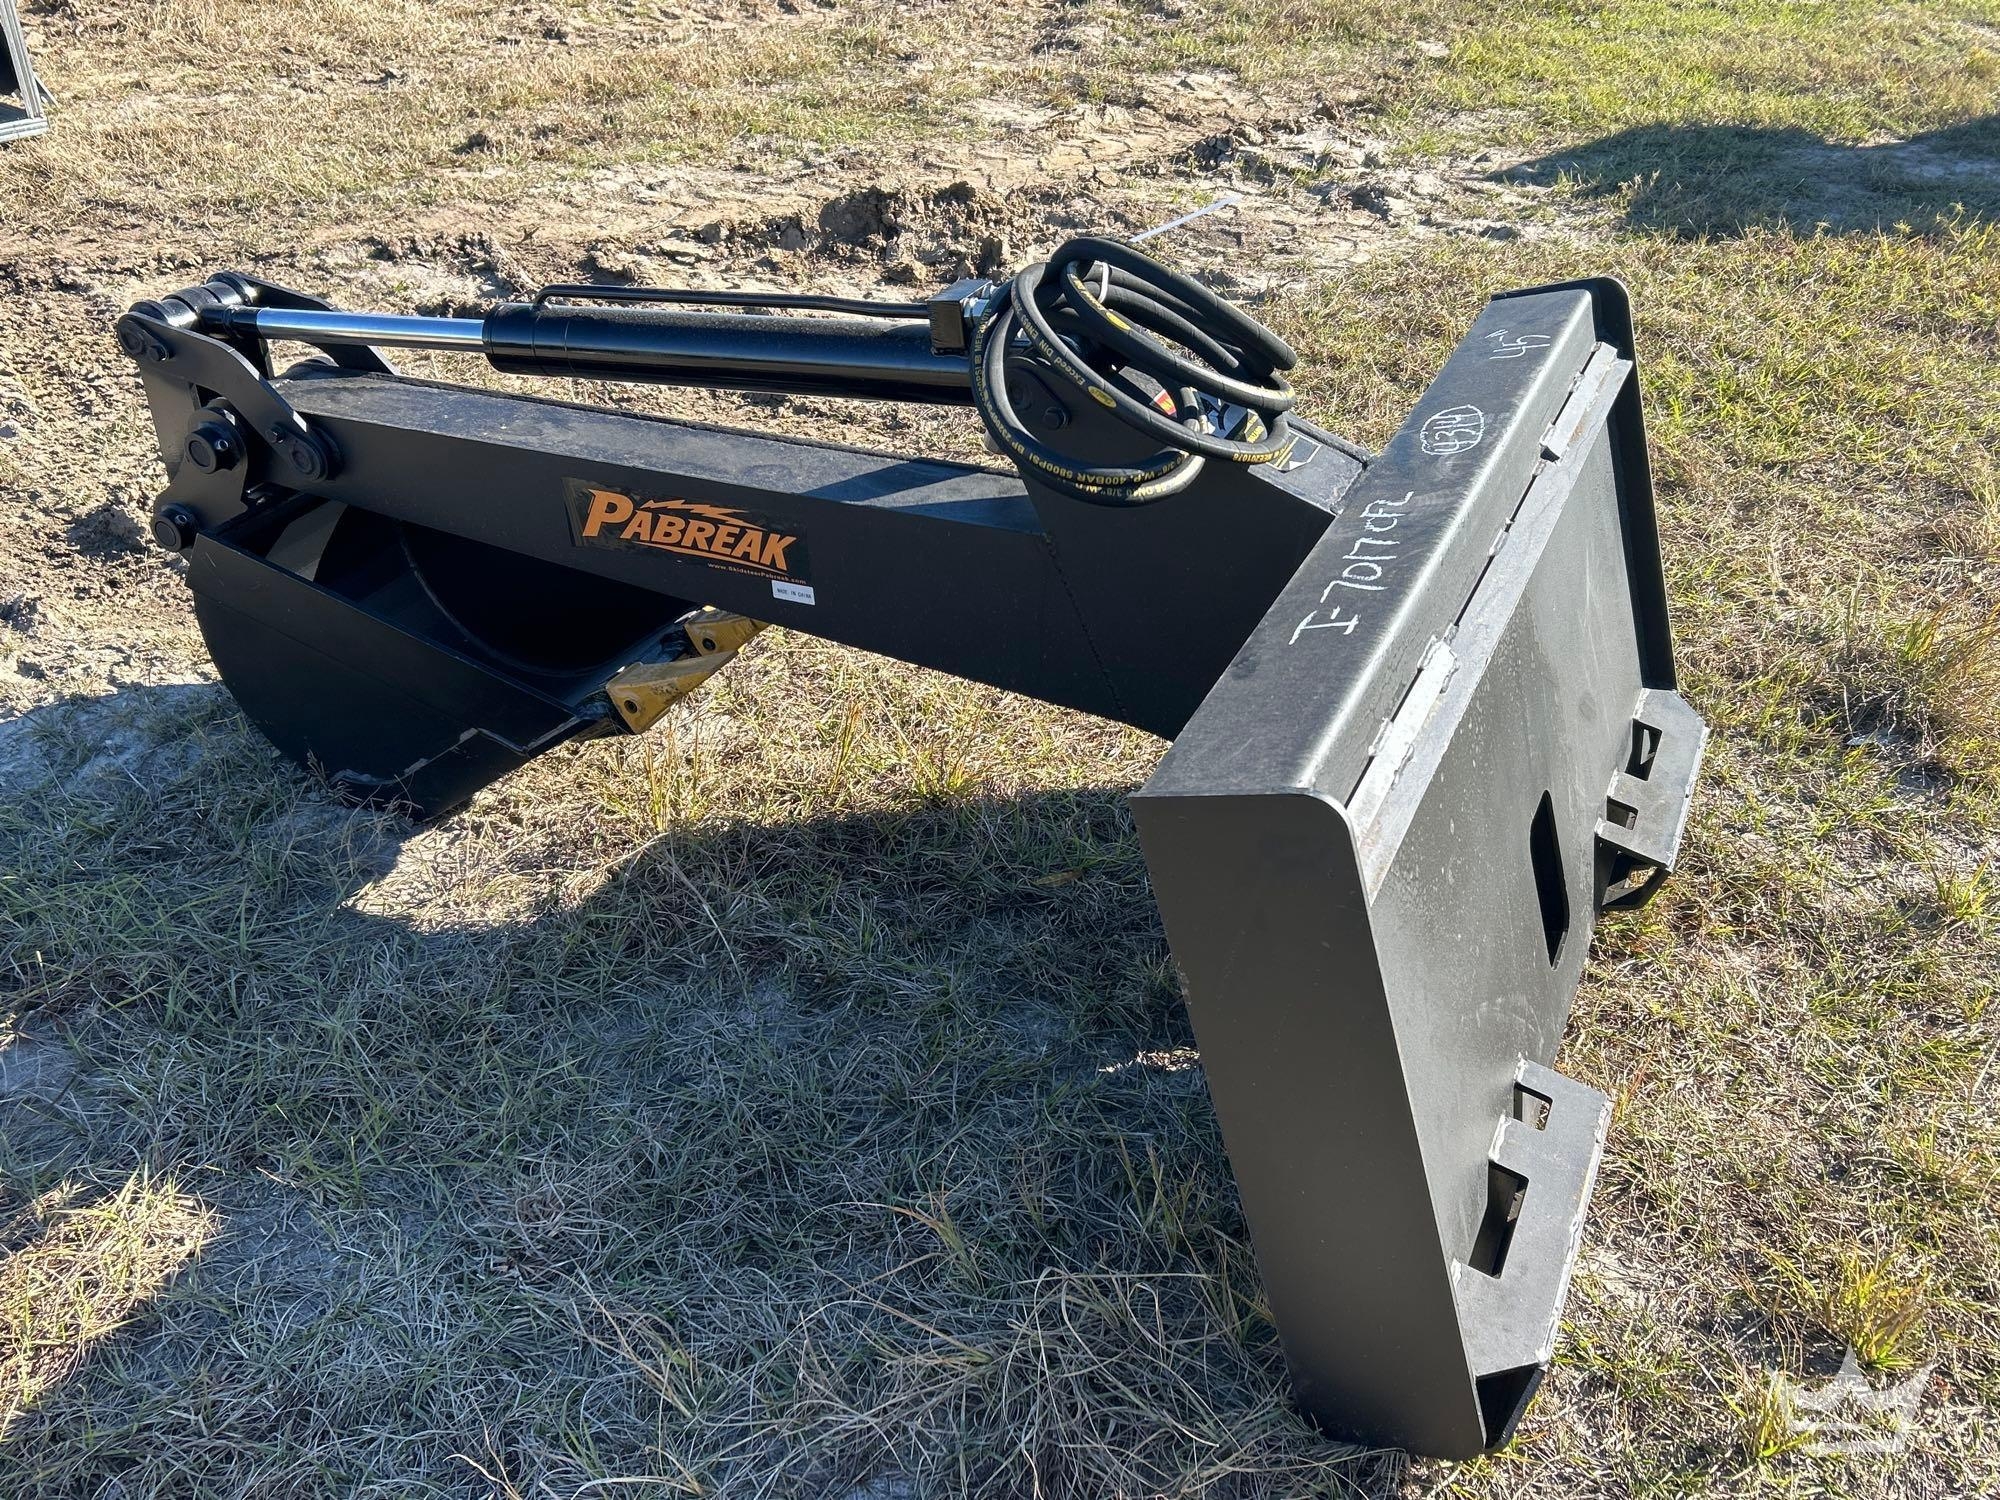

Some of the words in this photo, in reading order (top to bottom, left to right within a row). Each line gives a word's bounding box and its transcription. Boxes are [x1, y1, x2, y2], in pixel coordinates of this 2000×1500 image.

[1038, 339, 1054, 358] DIN
[1077, 472, 1127, 485] 400BAR
[582, 488, 797, 571] PABREAK
